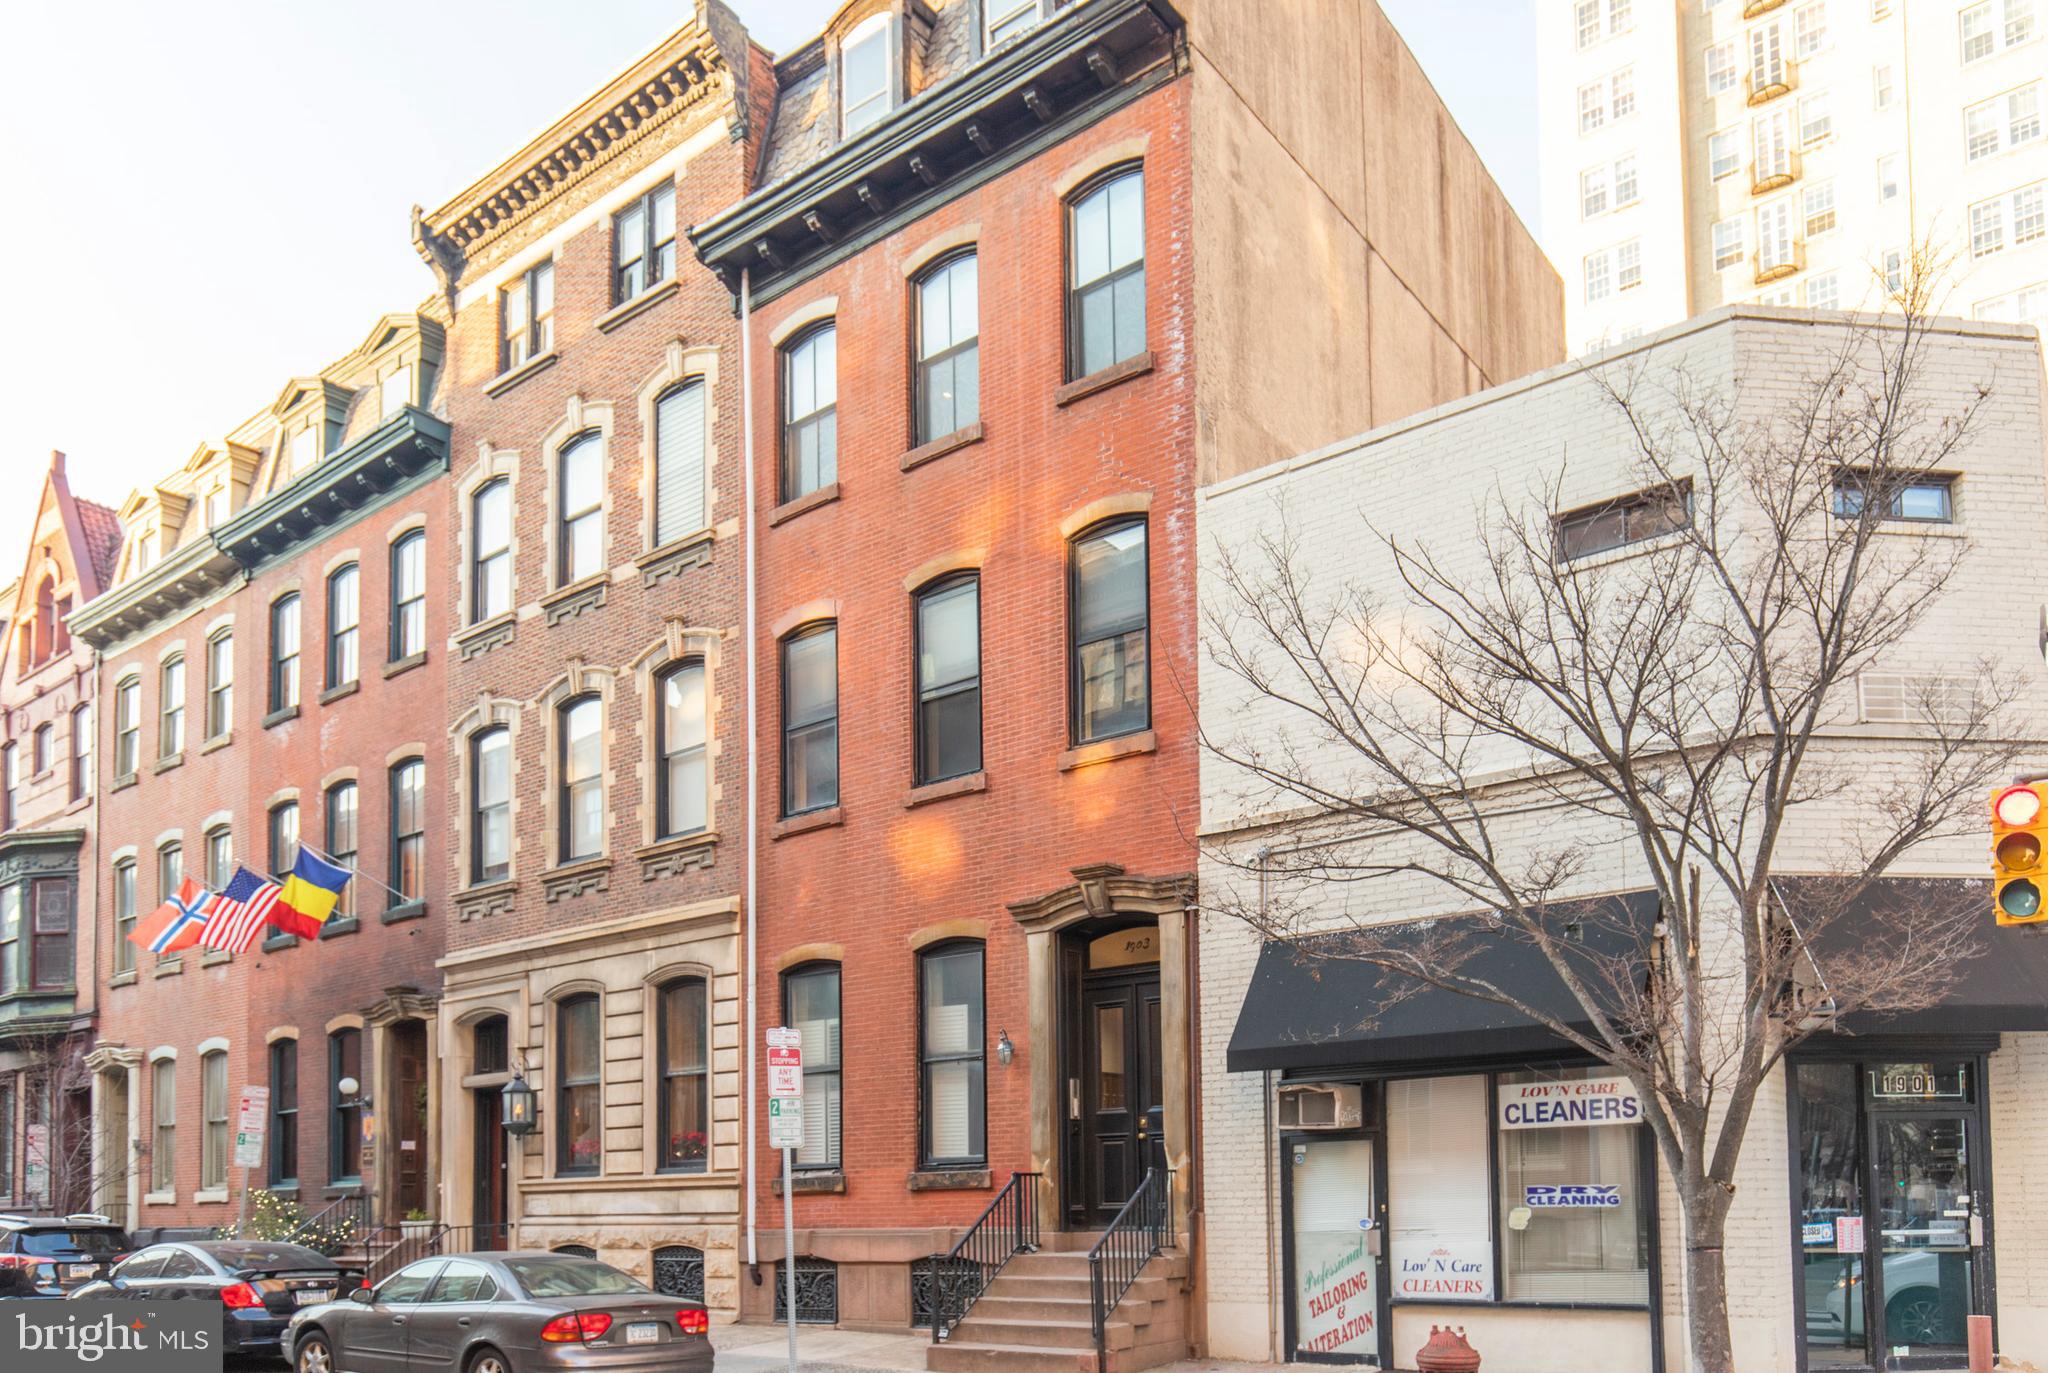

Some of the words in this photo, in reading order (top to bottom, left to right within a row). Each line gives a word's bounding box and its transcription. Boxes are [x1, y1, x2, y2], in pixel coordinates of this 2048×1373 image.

[1124, 937, 1150, 952] 1903
[778, 1077, 794, 1085] TIME
[1883, 1075, 1935, 1093] 1901
[1520, 1085, 1571, 1098] LOV'N
[1575, 1082, 1619, 1095] CARE
[771, 1101, 778, 1114] 2
[1504, 1096, 1638, 1125] CLEANERS
[1526, 1185, 1618, 1195] DRY
[1526, 1195, 1620, 1206] CLEANING
[1304, 1235, 1363, 1293] Professional
[1434, 1259, 1446, 1273] N
[1451, 1259, 1482, 1273] Care
[1403, 1279, 1483, 1293] CLEANERS
[1308, 1271, 1368, 1319] TAILORING
[1337, 1305, 1345, 1320] &
